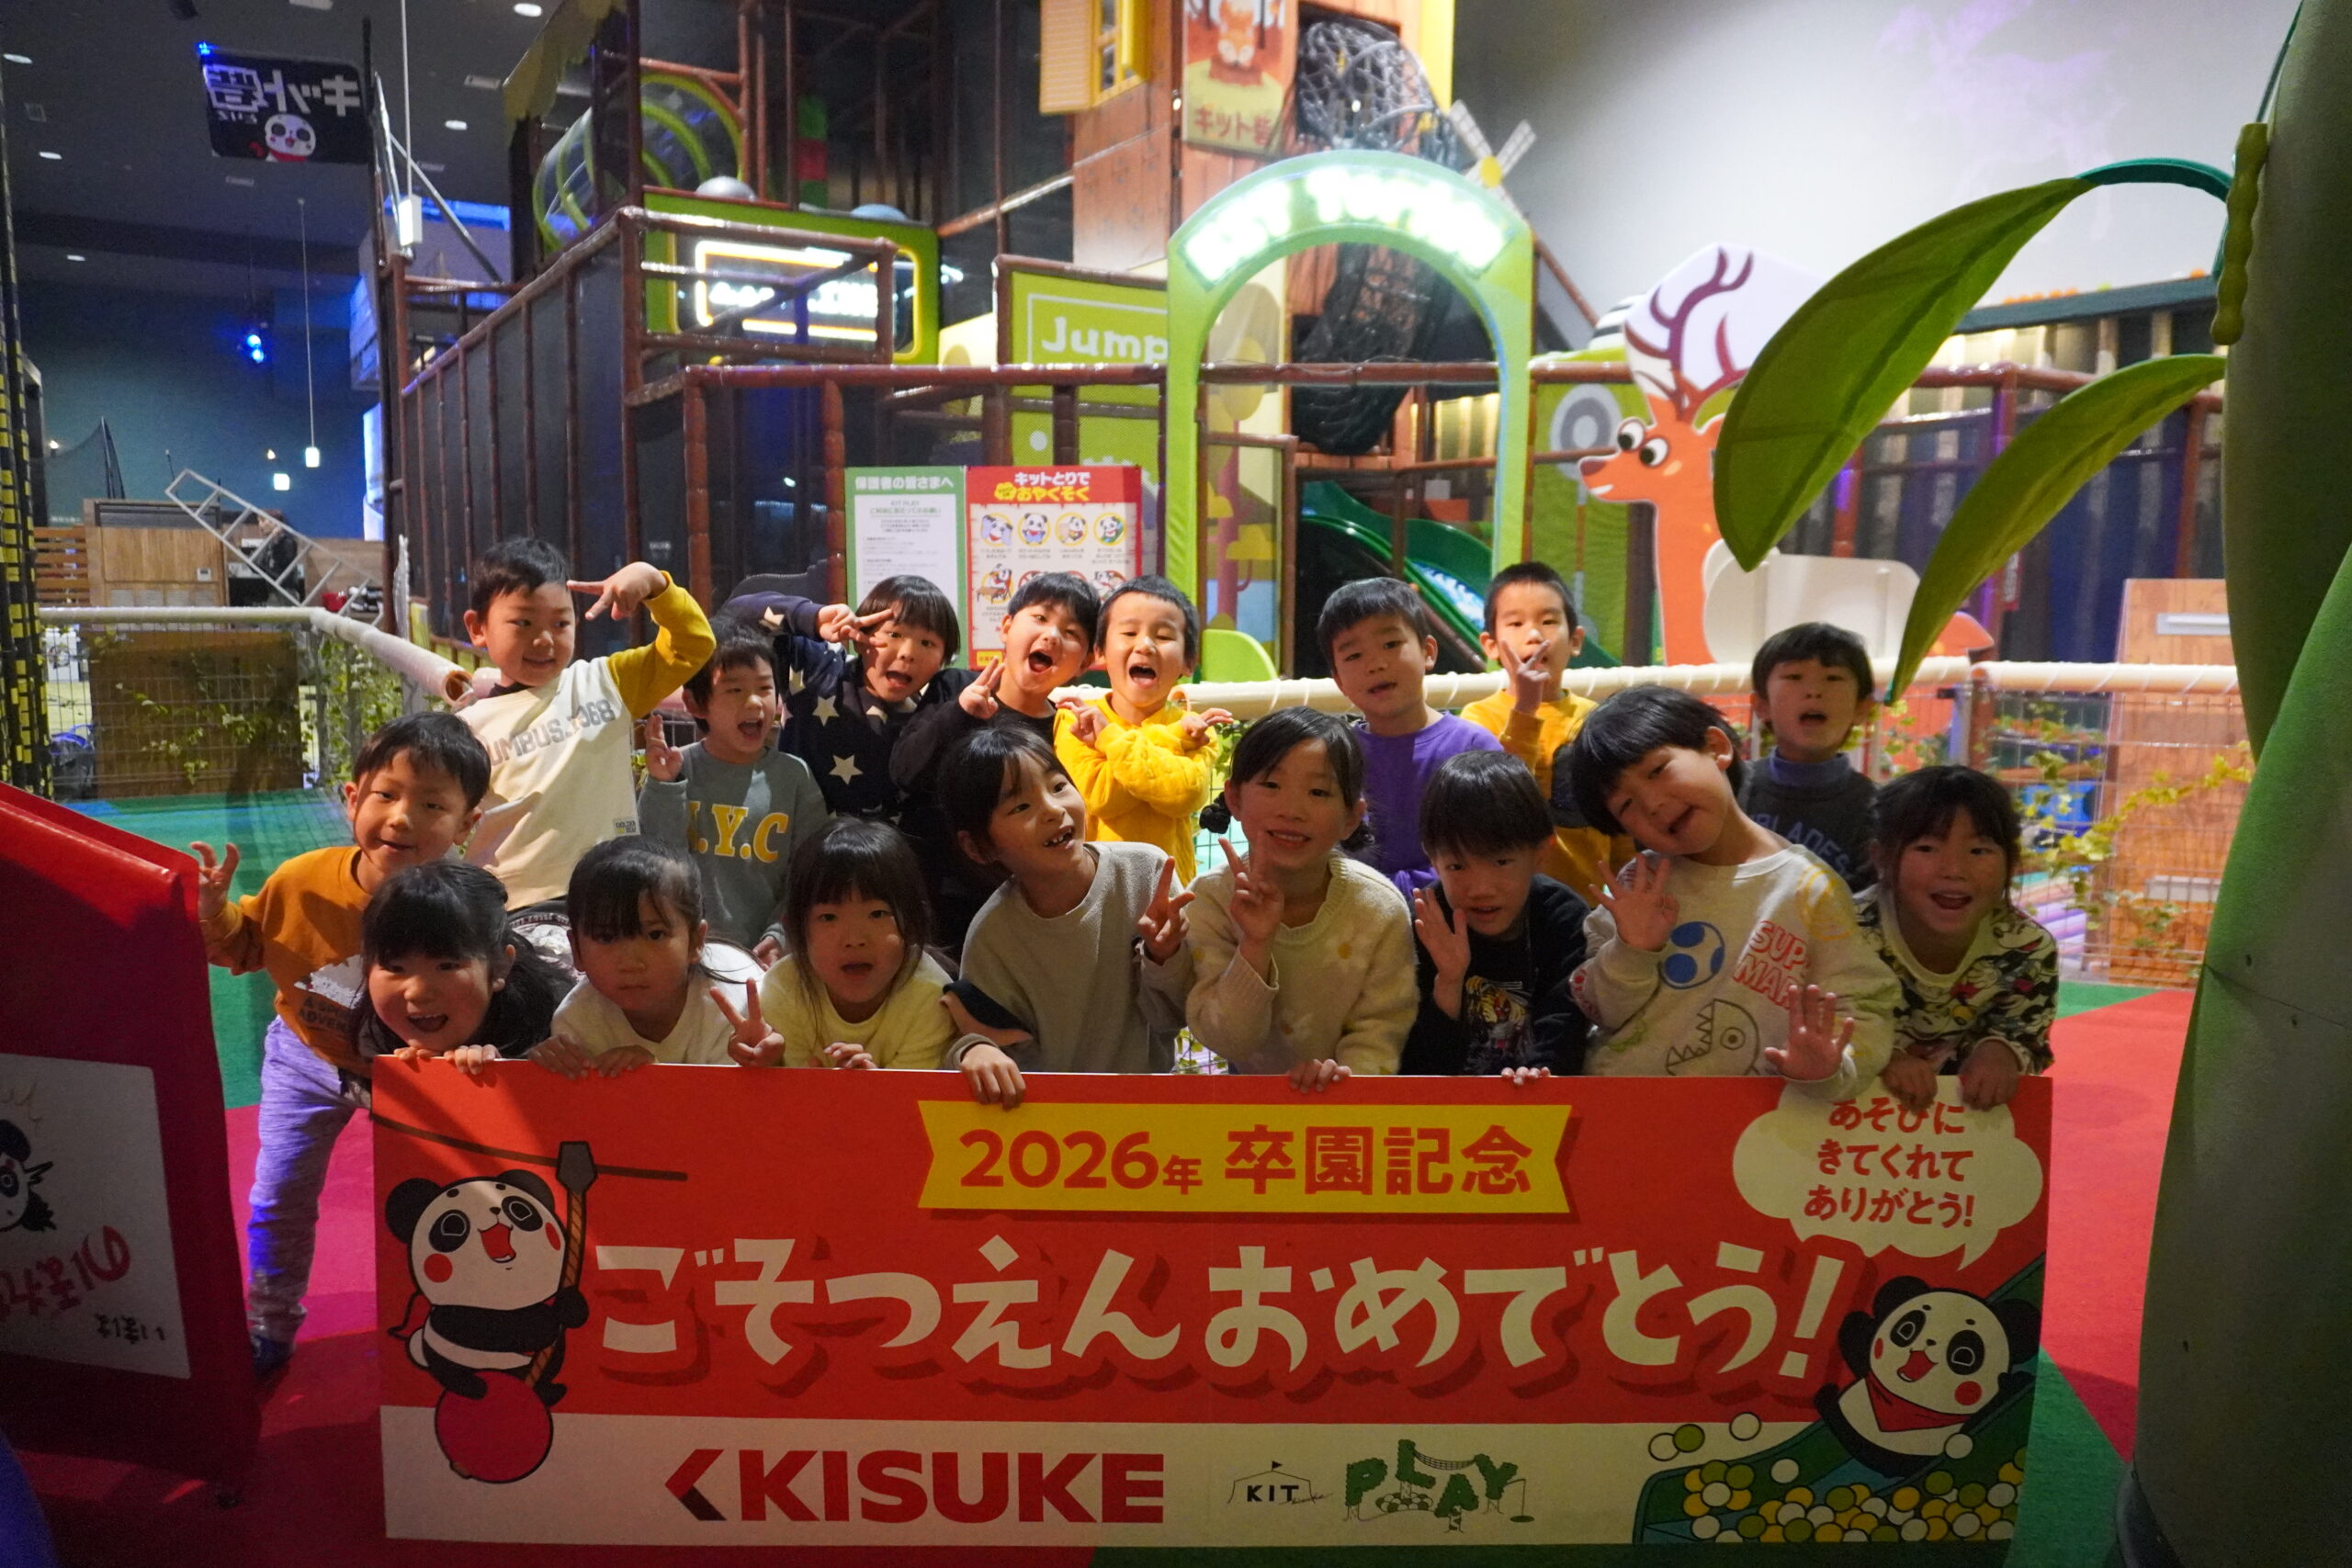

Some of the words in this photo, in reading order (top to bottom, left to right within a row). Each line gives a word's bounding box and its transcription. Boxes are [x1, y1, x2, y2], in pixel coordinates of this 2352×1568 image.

[1014, 471, 1091, 486] キットとりで
[1017, 486, 1090, 502] おやくそく
[474, 699, 616, 766] UMBUS.1968
[687, 800, 789, 863] .Y.C
[1748, 920, 1812, 970] SUP
[959, 1129, 1204, 1195] 2026年
[1225, 1123, 1532, 1195] 卒園記念
[1817, 1138, 1974, 1181] きてくれて
[1804, 1184, 1975, 1228] ありがとう!
[738, 1449, 1164, 1524] KISUKE
[1247, 1484, 1300, 1503] KIT
[1344, 1438, 1519, 1529] PLAY
